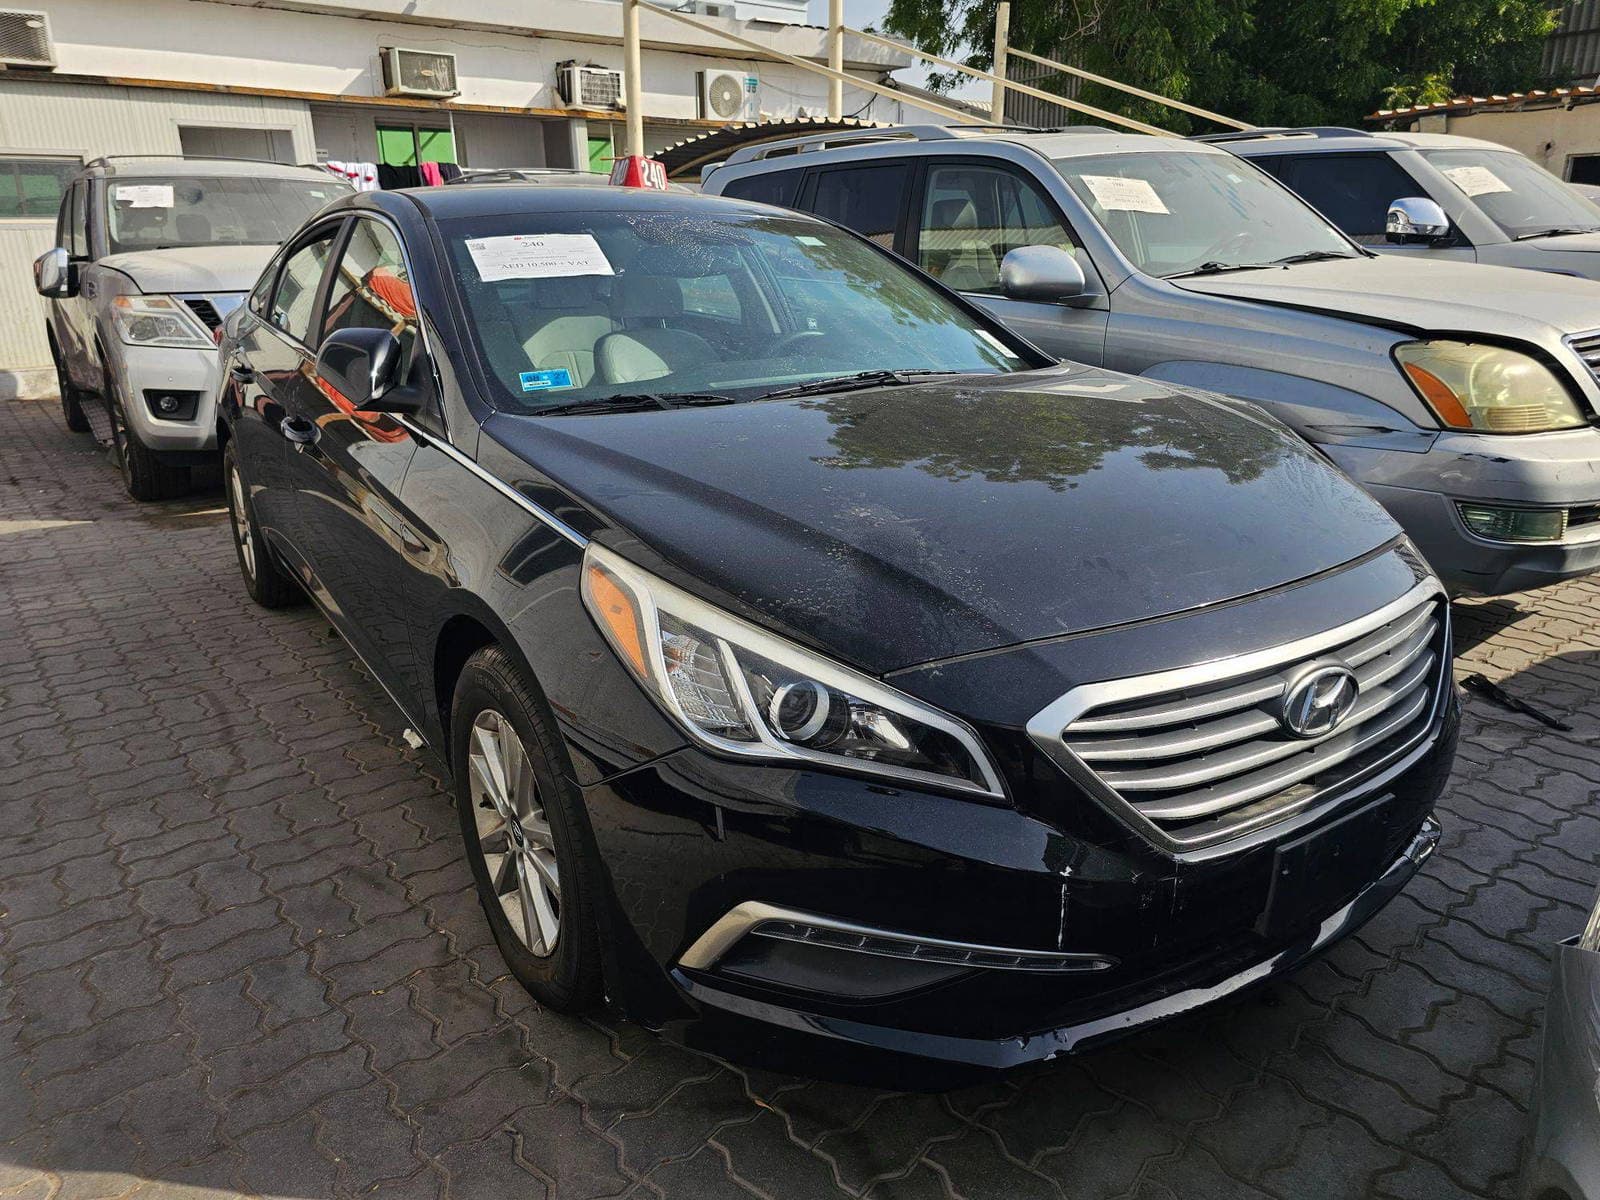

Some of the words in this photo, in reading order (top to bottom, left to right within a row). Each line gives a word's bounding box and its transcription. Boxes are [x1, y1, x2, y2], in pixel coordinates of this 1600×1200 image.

[640, 159, 666, 191] 240
[520, 240, 545, 248] 240
[501, 262, 525, 270] AED
